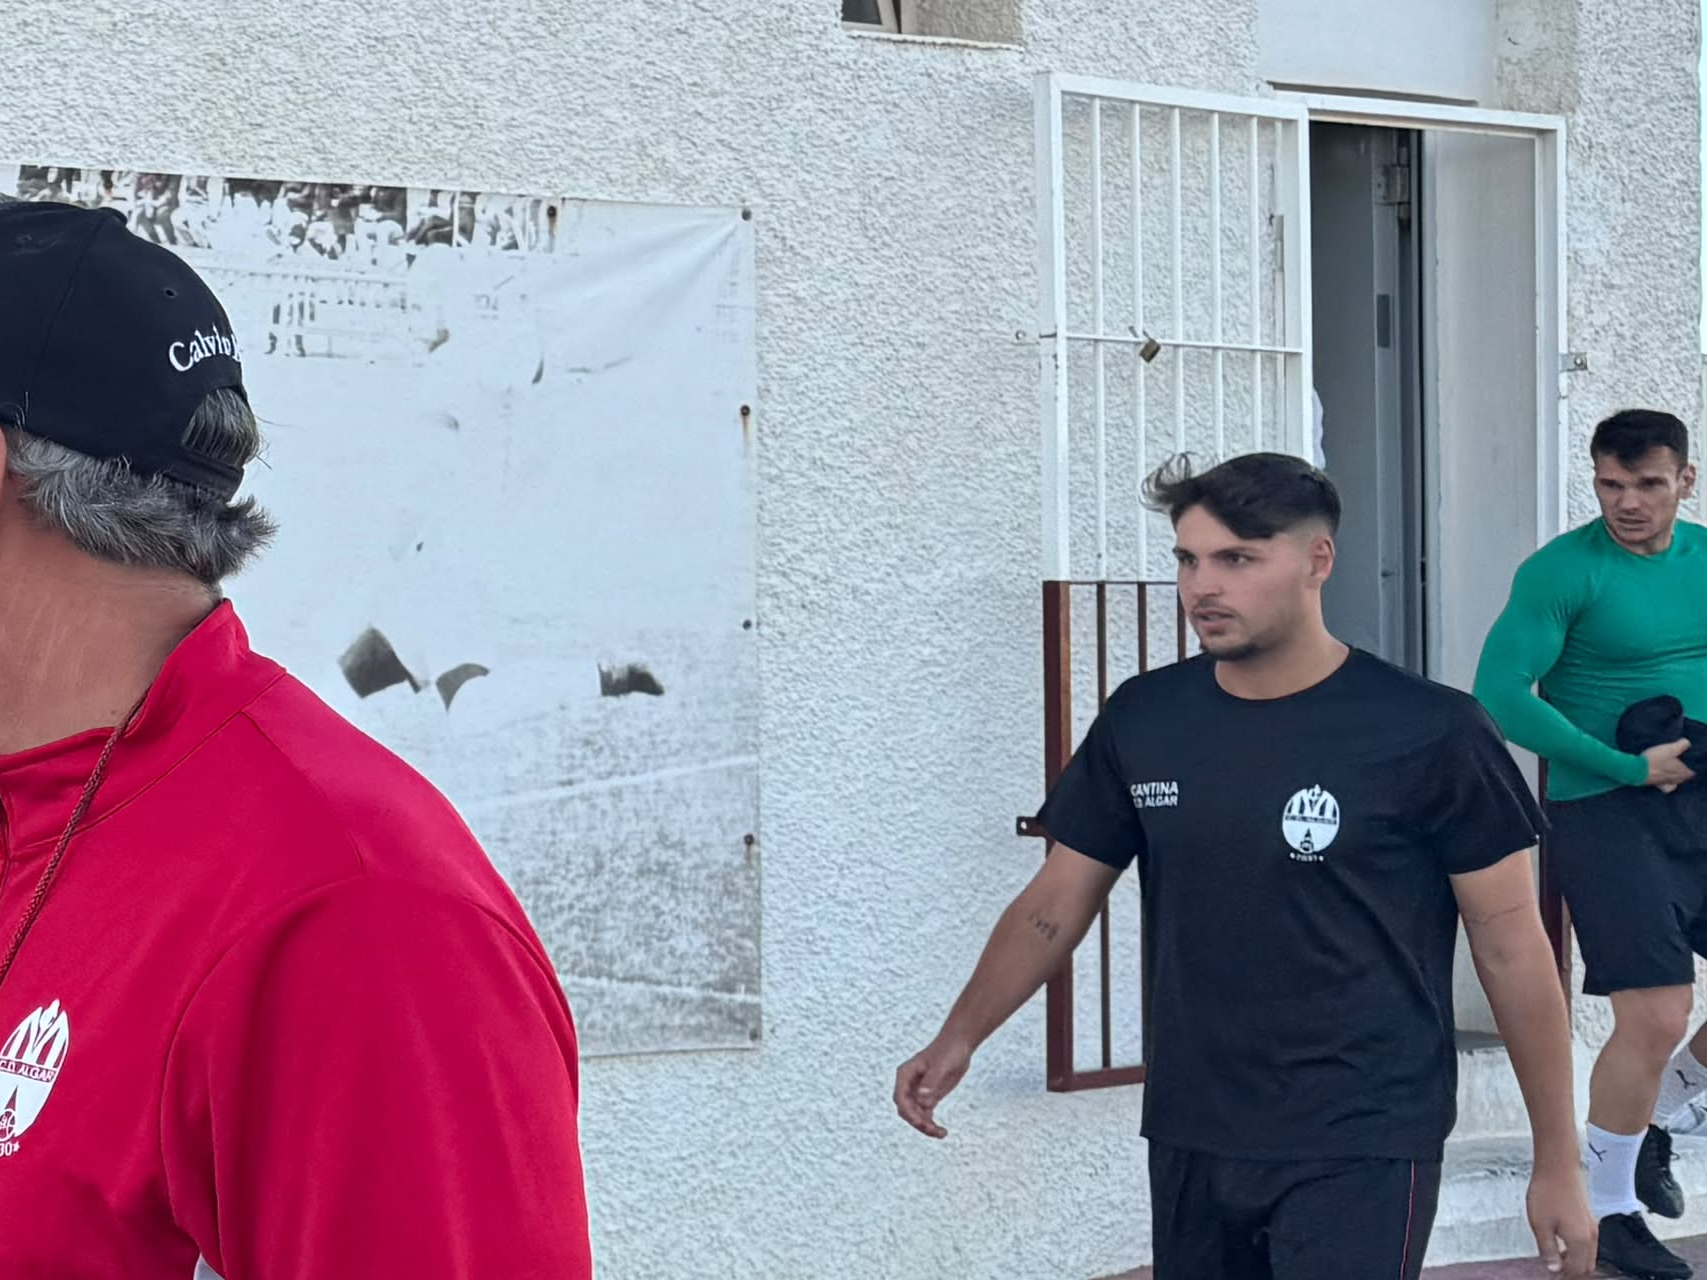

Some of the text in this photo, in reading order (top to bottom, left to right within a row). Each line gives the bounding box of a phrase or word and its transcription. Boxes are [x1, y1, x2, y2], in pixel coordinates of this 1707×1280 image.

[1130, 781, 1179, 797] CANTINA
[1145, 795, 1179, 808] ALGAR
[18, 1063, 56, 1083] ALGAR
